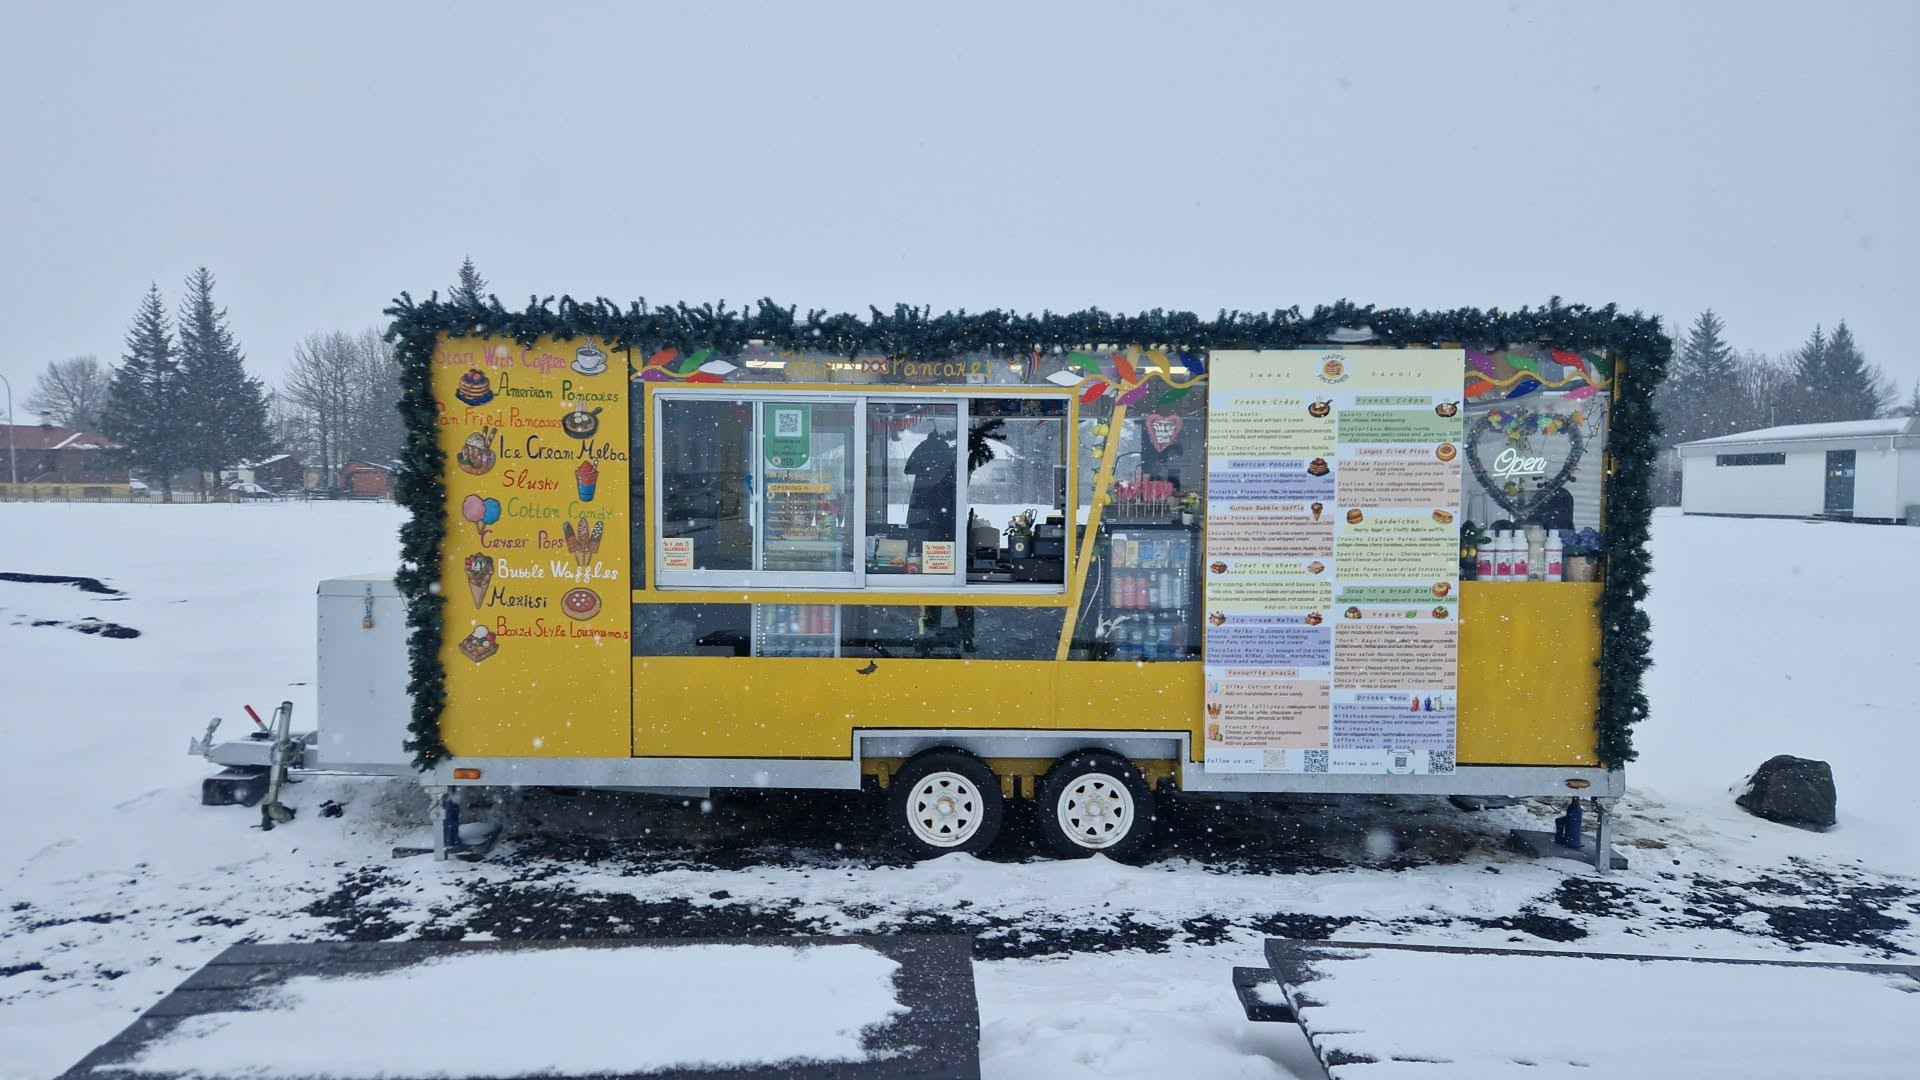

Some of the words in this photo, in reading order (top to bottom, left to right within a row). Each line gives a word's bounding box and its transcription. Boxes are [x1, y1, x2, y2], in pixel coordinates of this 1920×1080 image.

[521, 350, 566, 377] Coffee
[464, 407, 504, 427] Fried
[500, 435, 522, 459] Ice
[526, 435, 574, 460] Cream
[576, 440, 628, 461] Melba
[1493, 448, 1547, 479] Open
[508, 497, 560, 518] Cotton
[568, 500, 614, 520] Candy
[498, 559, 544, 578] Bubble
[551, 560, 619, 583] Waffles
